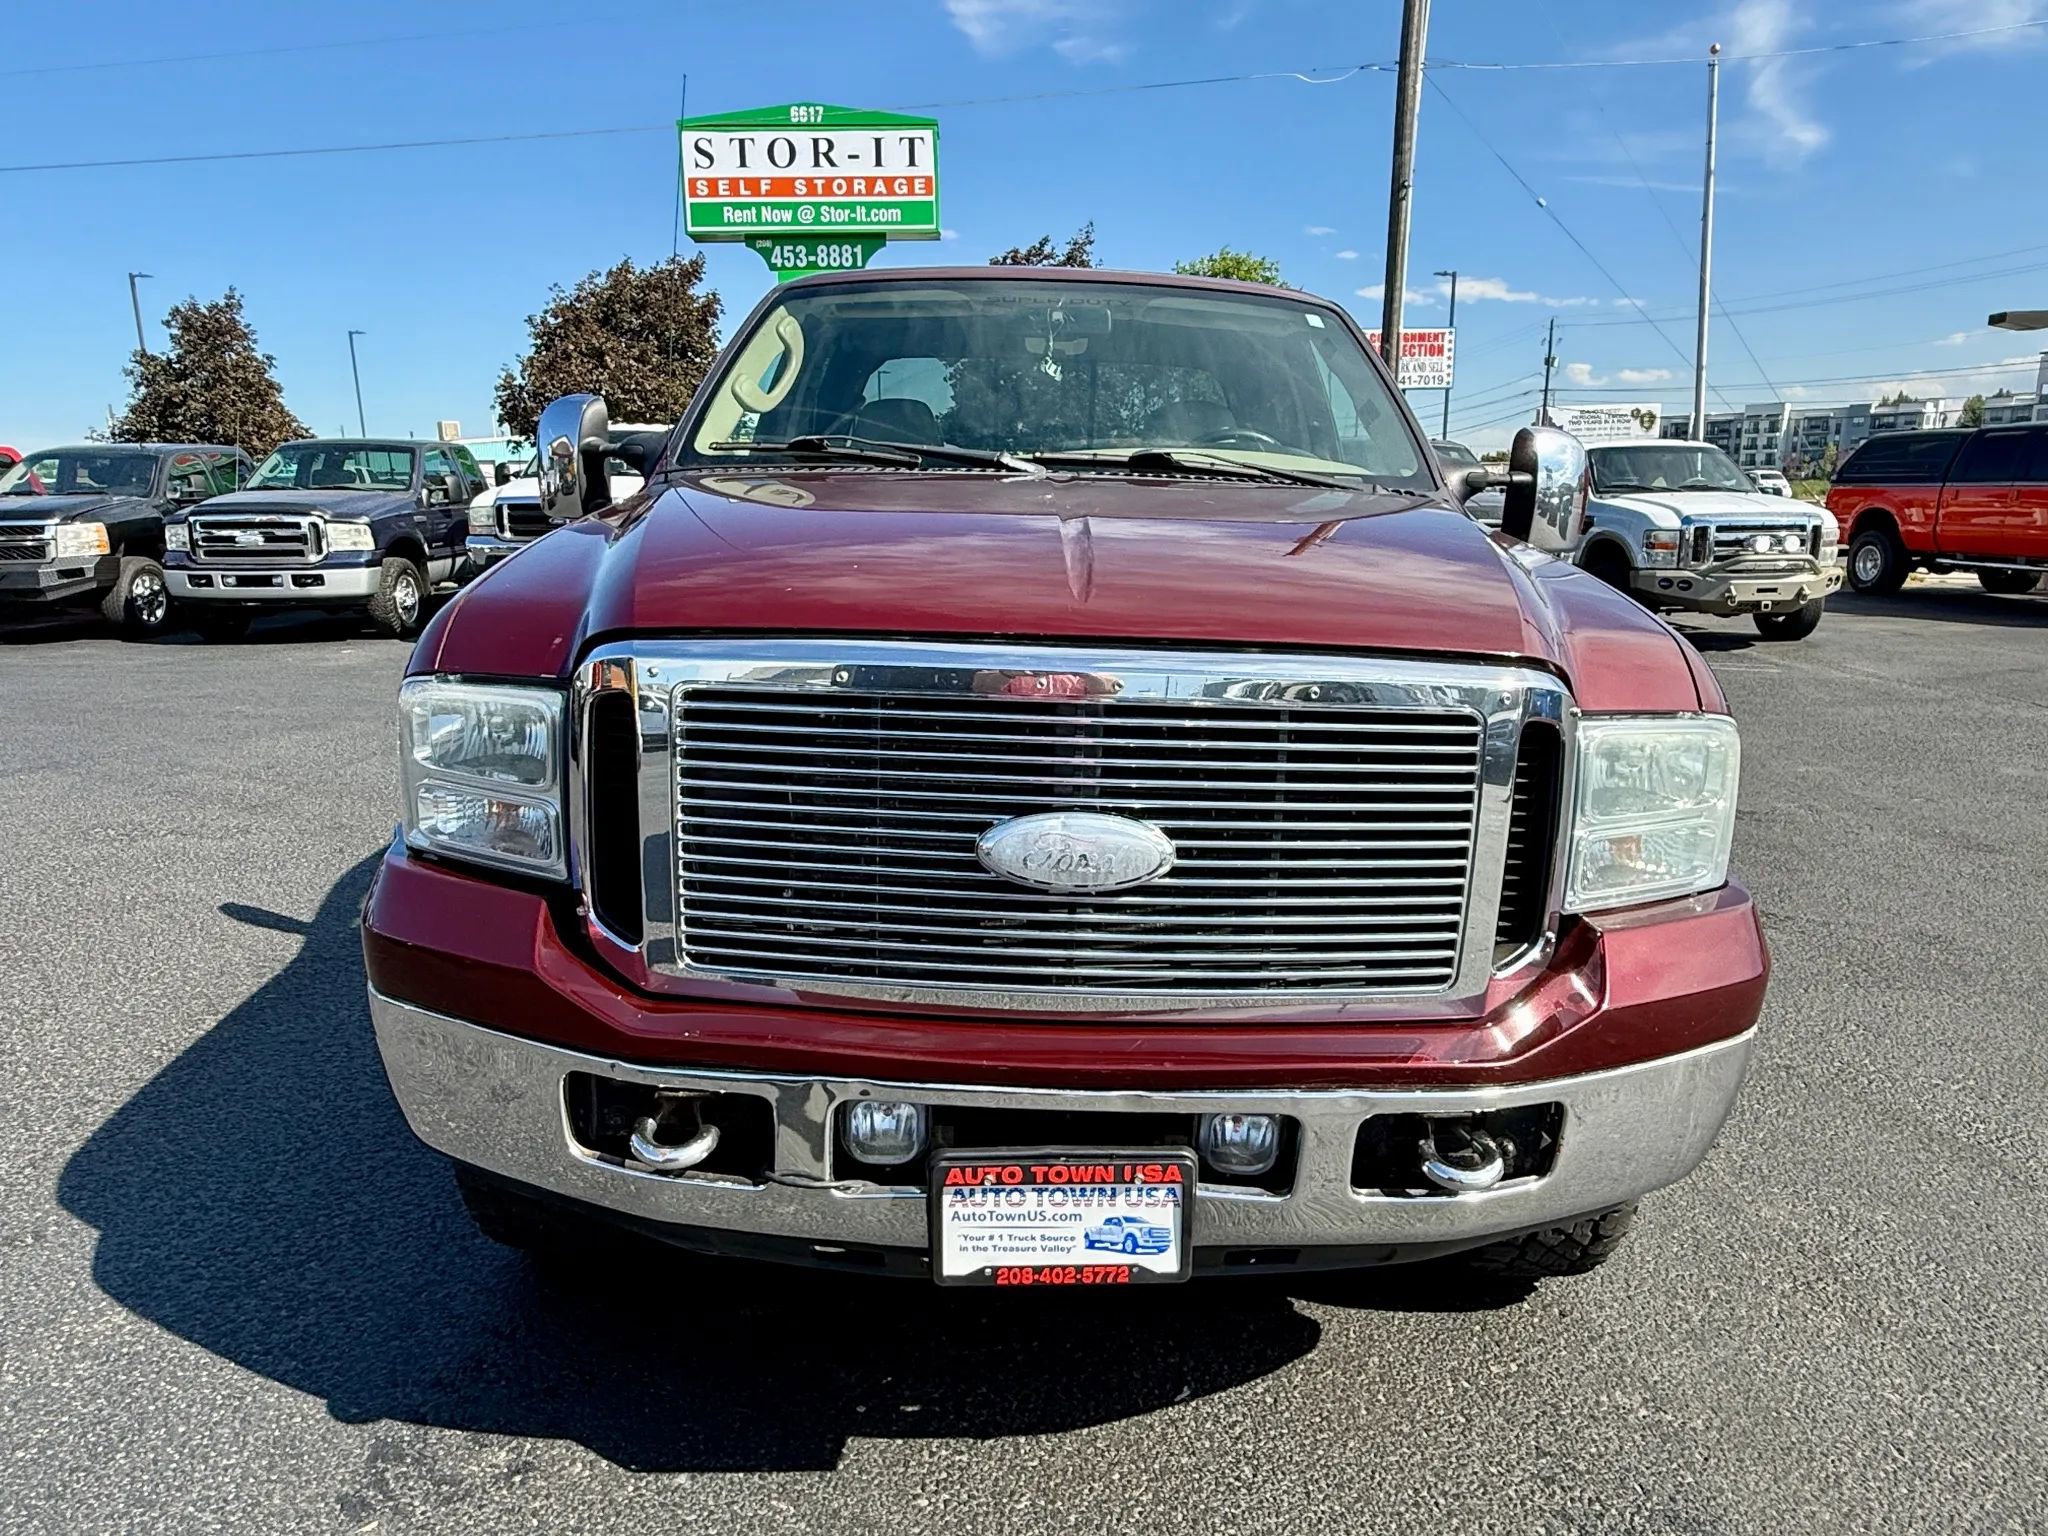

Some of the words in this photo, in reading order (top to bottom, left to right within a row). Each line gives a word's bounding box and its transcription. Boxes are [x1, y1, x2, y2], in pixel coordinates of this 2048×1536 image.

[790, 106, 824, 123] 6617
[694, 137, 925, 169] STOR-IT
[695, 179, 772, 196] SELF
[794, 178, 927, 195] STORAGE
[723, 206, 757, 223] Rent
[761, 206, 792, 222] Now
[797, 205, 816, 224] @
[820, 205, 901, 222] Stor-It.com
[771, 244, 863, 268] 453-8881
[945, 1165, 1024, 1185] AUTO
[1031, 1165, 1115, 1184] TOWN
[1124, 1164, 1183, 1183] USA
[949, 1187, 1025, 1208] AUTO
[1032, 1187, 1117, 1208] TOWN
[1124, 1187, 1181, 1208] USA
[951, 1210, 1083, 1222] AutoTownUS.com
